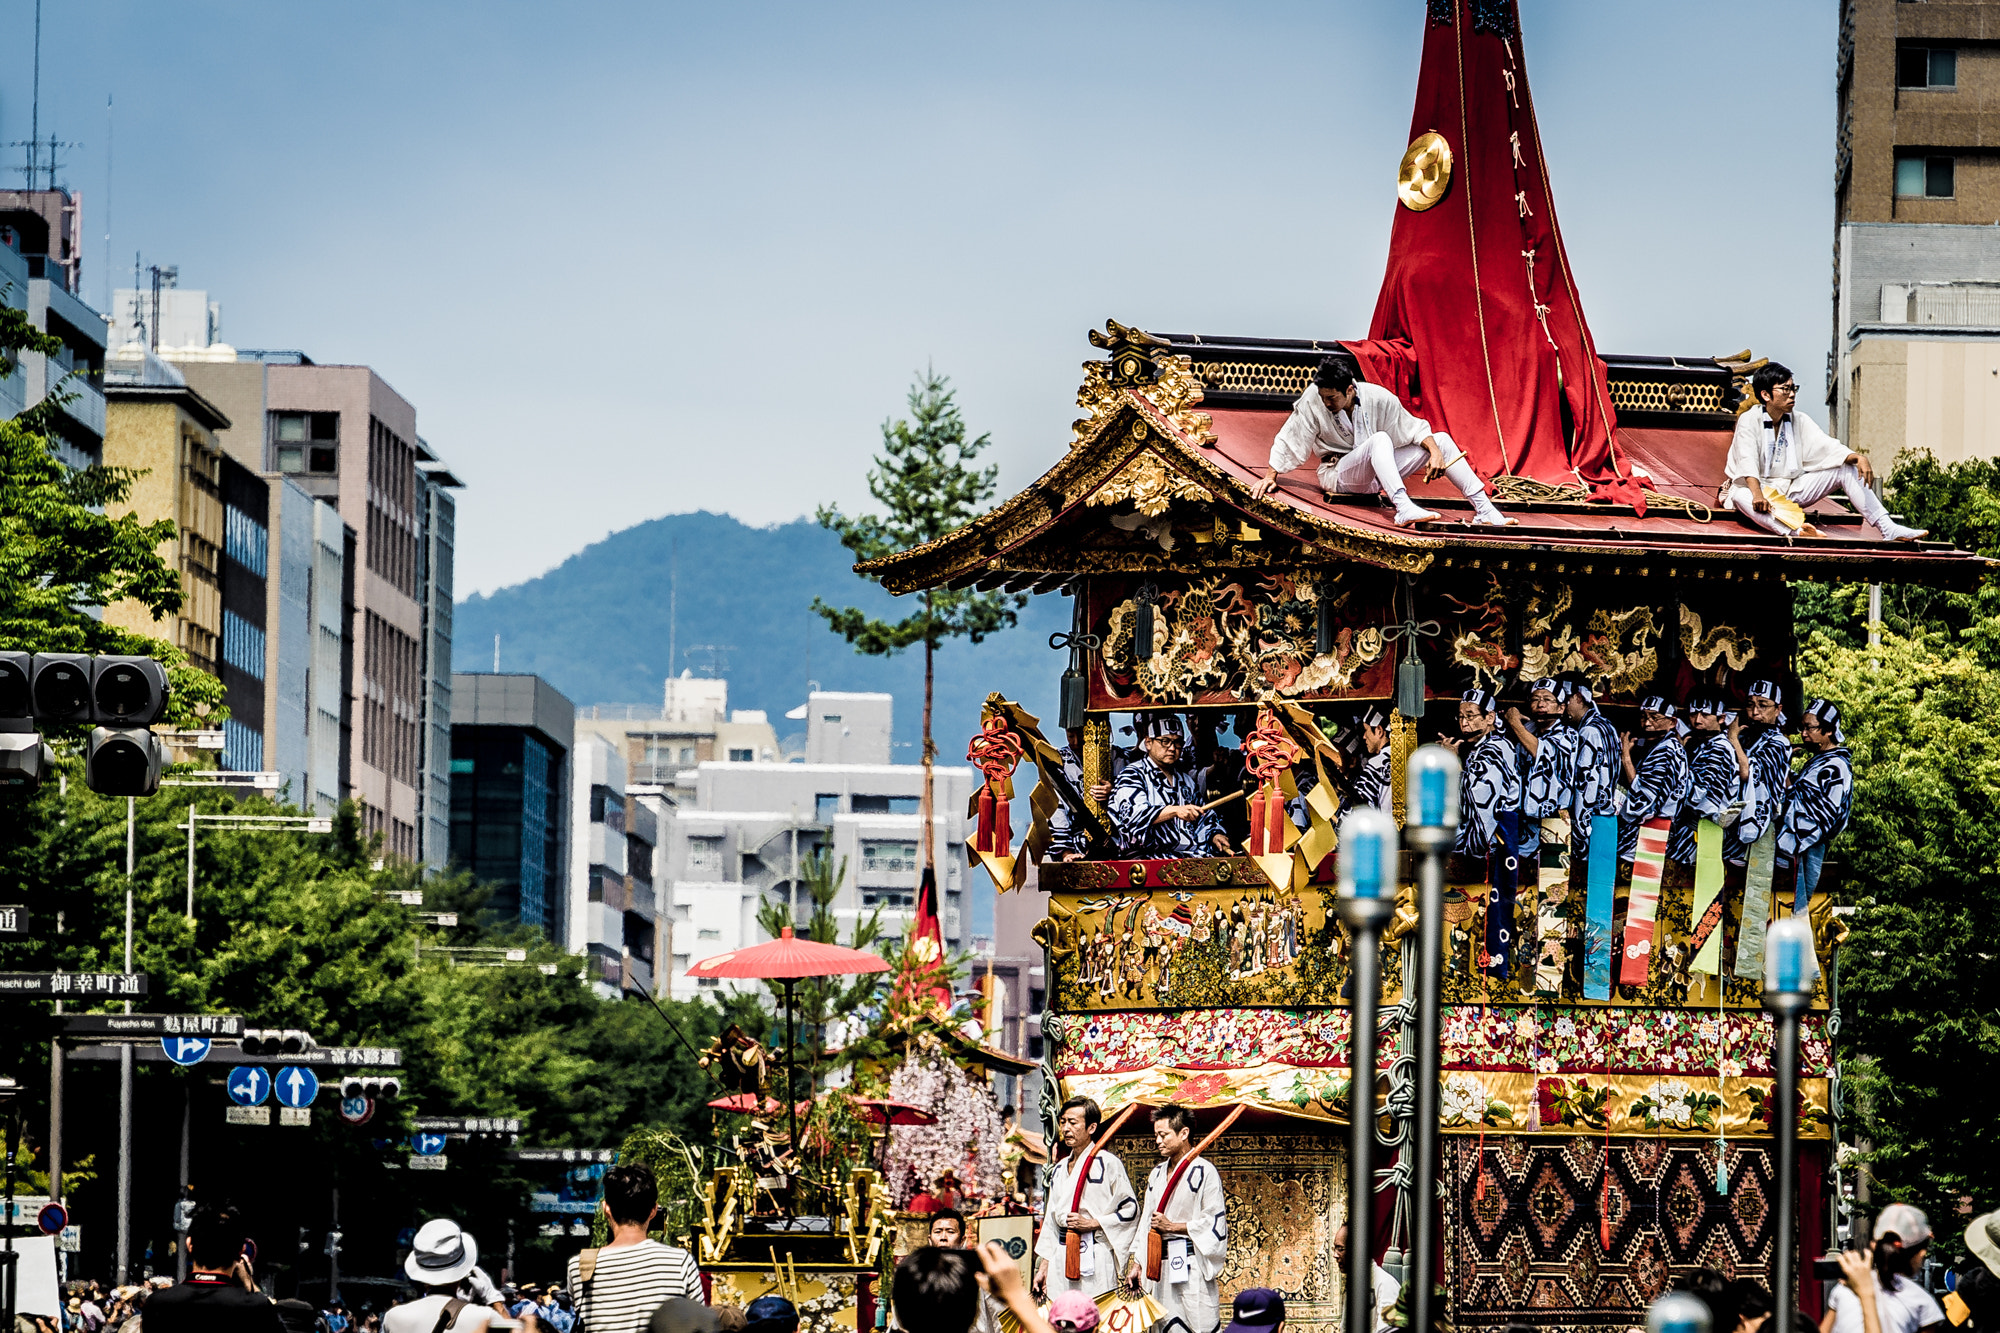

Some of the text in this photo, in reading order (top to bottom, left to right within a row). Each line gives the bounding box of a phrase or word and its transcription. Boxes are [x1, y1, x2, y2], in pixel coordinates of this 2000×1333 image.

[24, 978, 40, 989] dori
[50, 974, 140, 993] 御幸町通
[343, 1096, 365, 1115] 50
